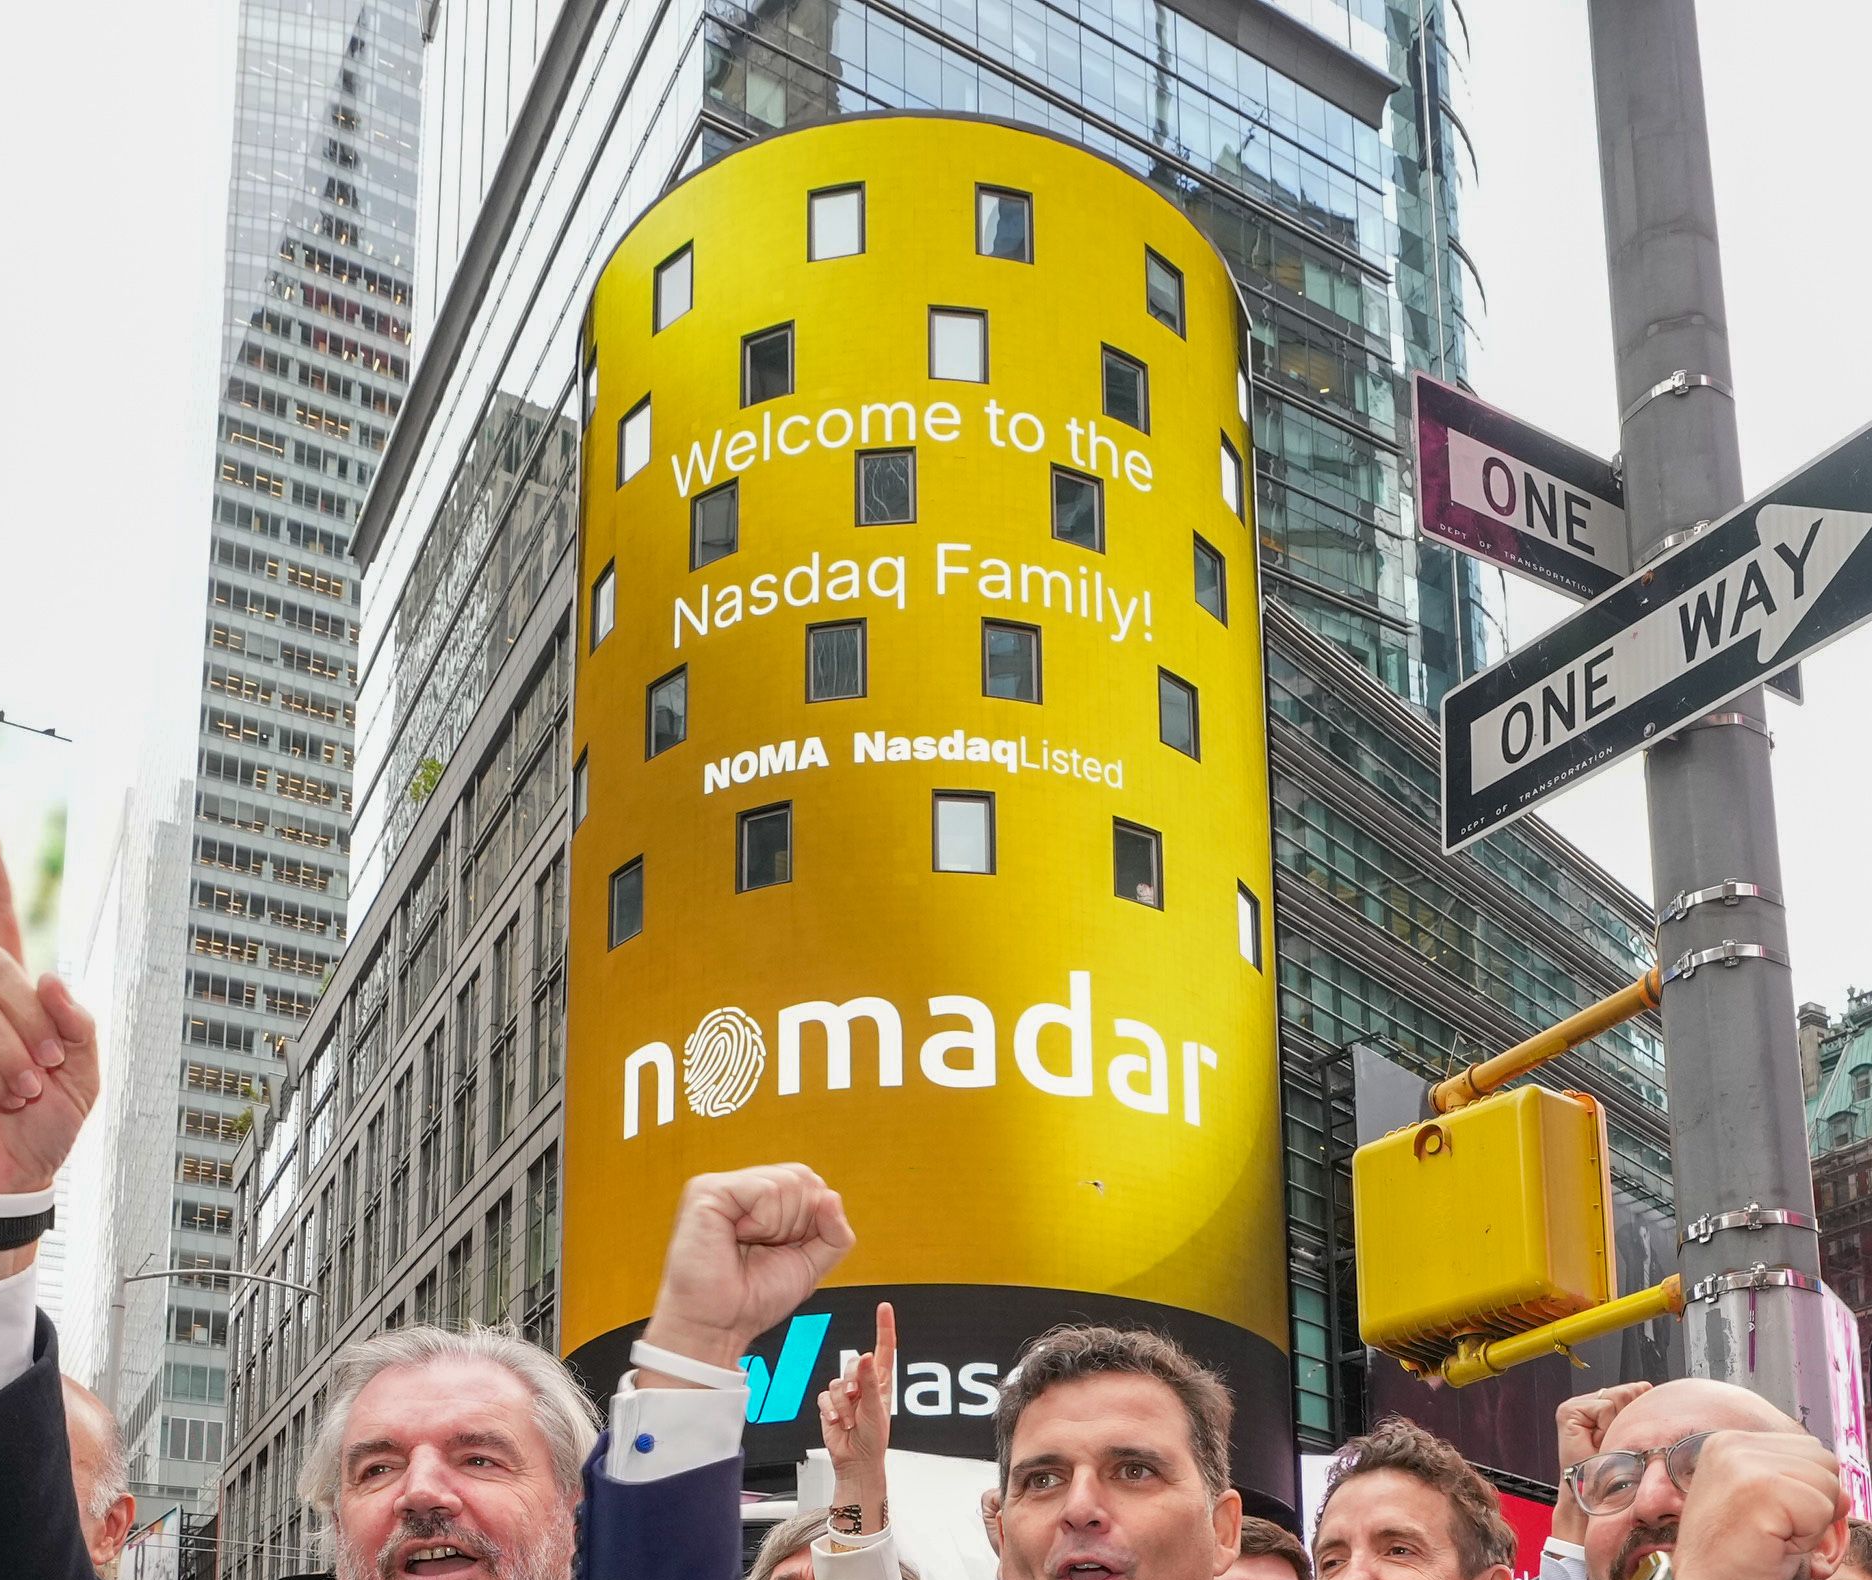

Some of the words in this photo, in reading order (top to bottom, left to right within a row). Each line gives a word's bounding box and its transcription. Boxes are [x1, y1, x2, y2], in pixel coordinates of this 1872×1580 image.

[671, 399, 961, 498] Welcome
[985, 398, 1045, 454] to
[1065, 416, 1154, 493] the
[1481, 456, 1595, 556] ONE
[673, 551, 906, 649] Nasdaq
[936, 542, 1152, 642] Family!
[1439, 523, 1467, 540] DEPT
[1479, 540, 1492, 550] OF
[1504, 550, 1594, 596] TRANSPORTATION
[1500, 646, 1616, 765] ONE
[1678, 516, 1824, 665] WAY
[703, 736, 829, 795] NOMA
[1460, 816, 1486, 836] DEPT
[1495, 804, 1509, 816] OF
[1519, 745, 1613, 803] TRANSPORTATION
[623, 970, 1218, 1140] nomadar
